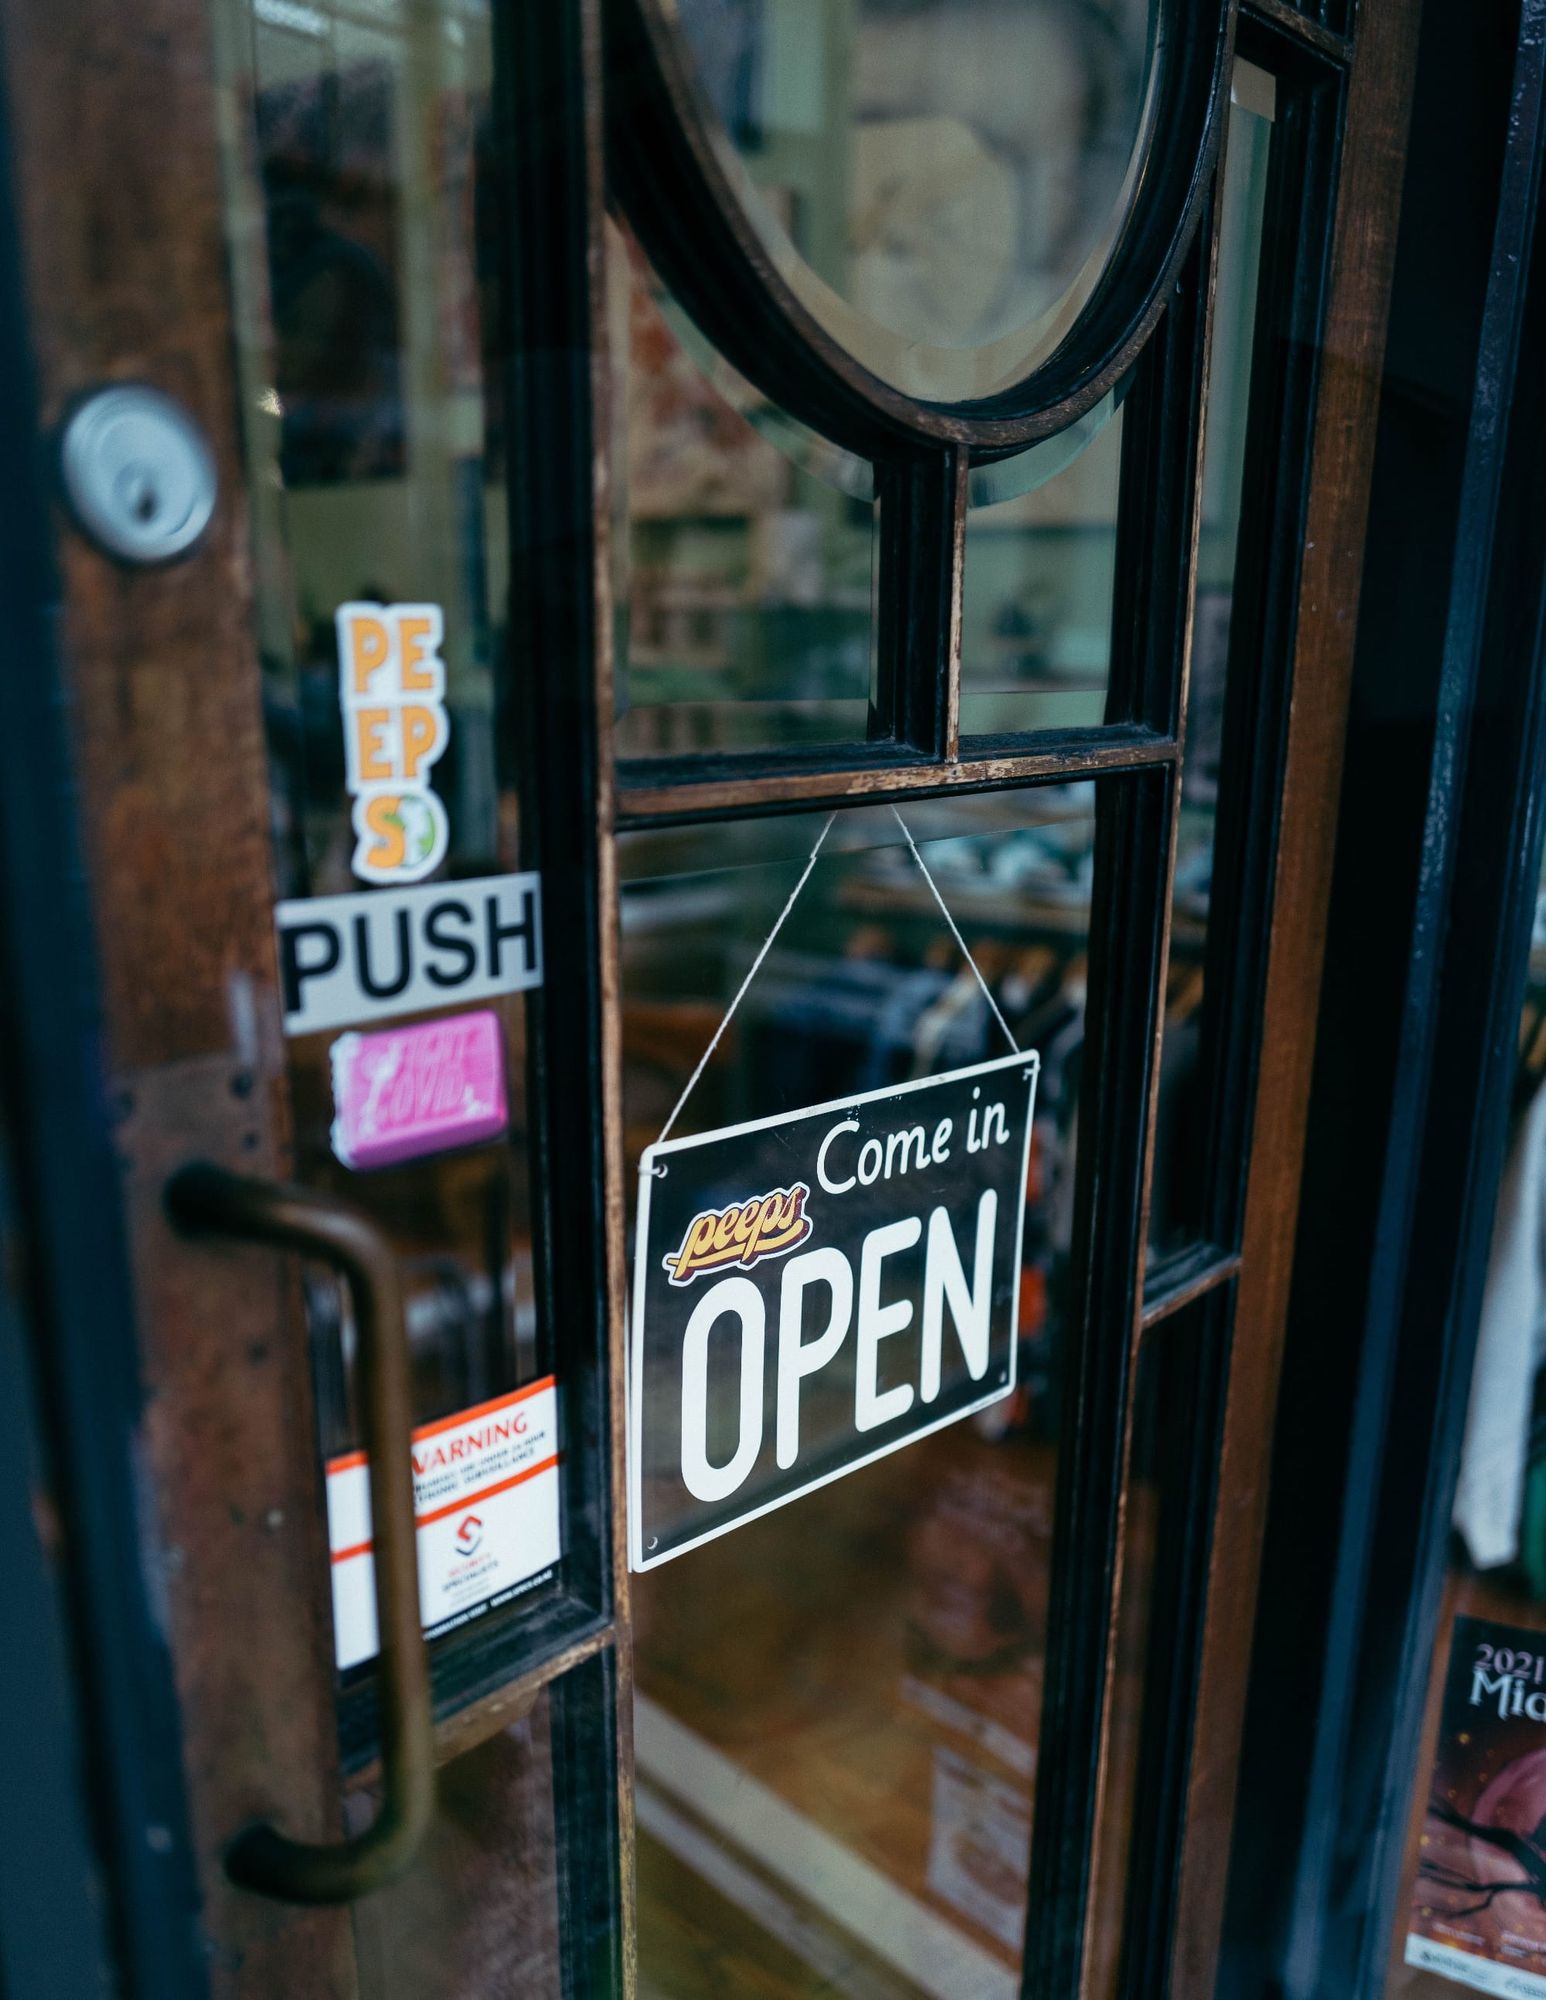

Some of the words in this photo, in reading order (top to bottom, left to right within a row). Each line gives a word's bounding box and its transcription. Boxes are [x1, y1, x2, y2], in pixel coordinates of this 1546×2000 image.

[279, 889, 538, 1013] PUSH
[816, 1119, 953, 1195] Come
[966, 1086, 1010, 1154] in
[666, 1186, 808, 1281] peeps
[681, 1189, 998, 1503] OPEN
[1473, 1643, 1544, 1685] 2021
